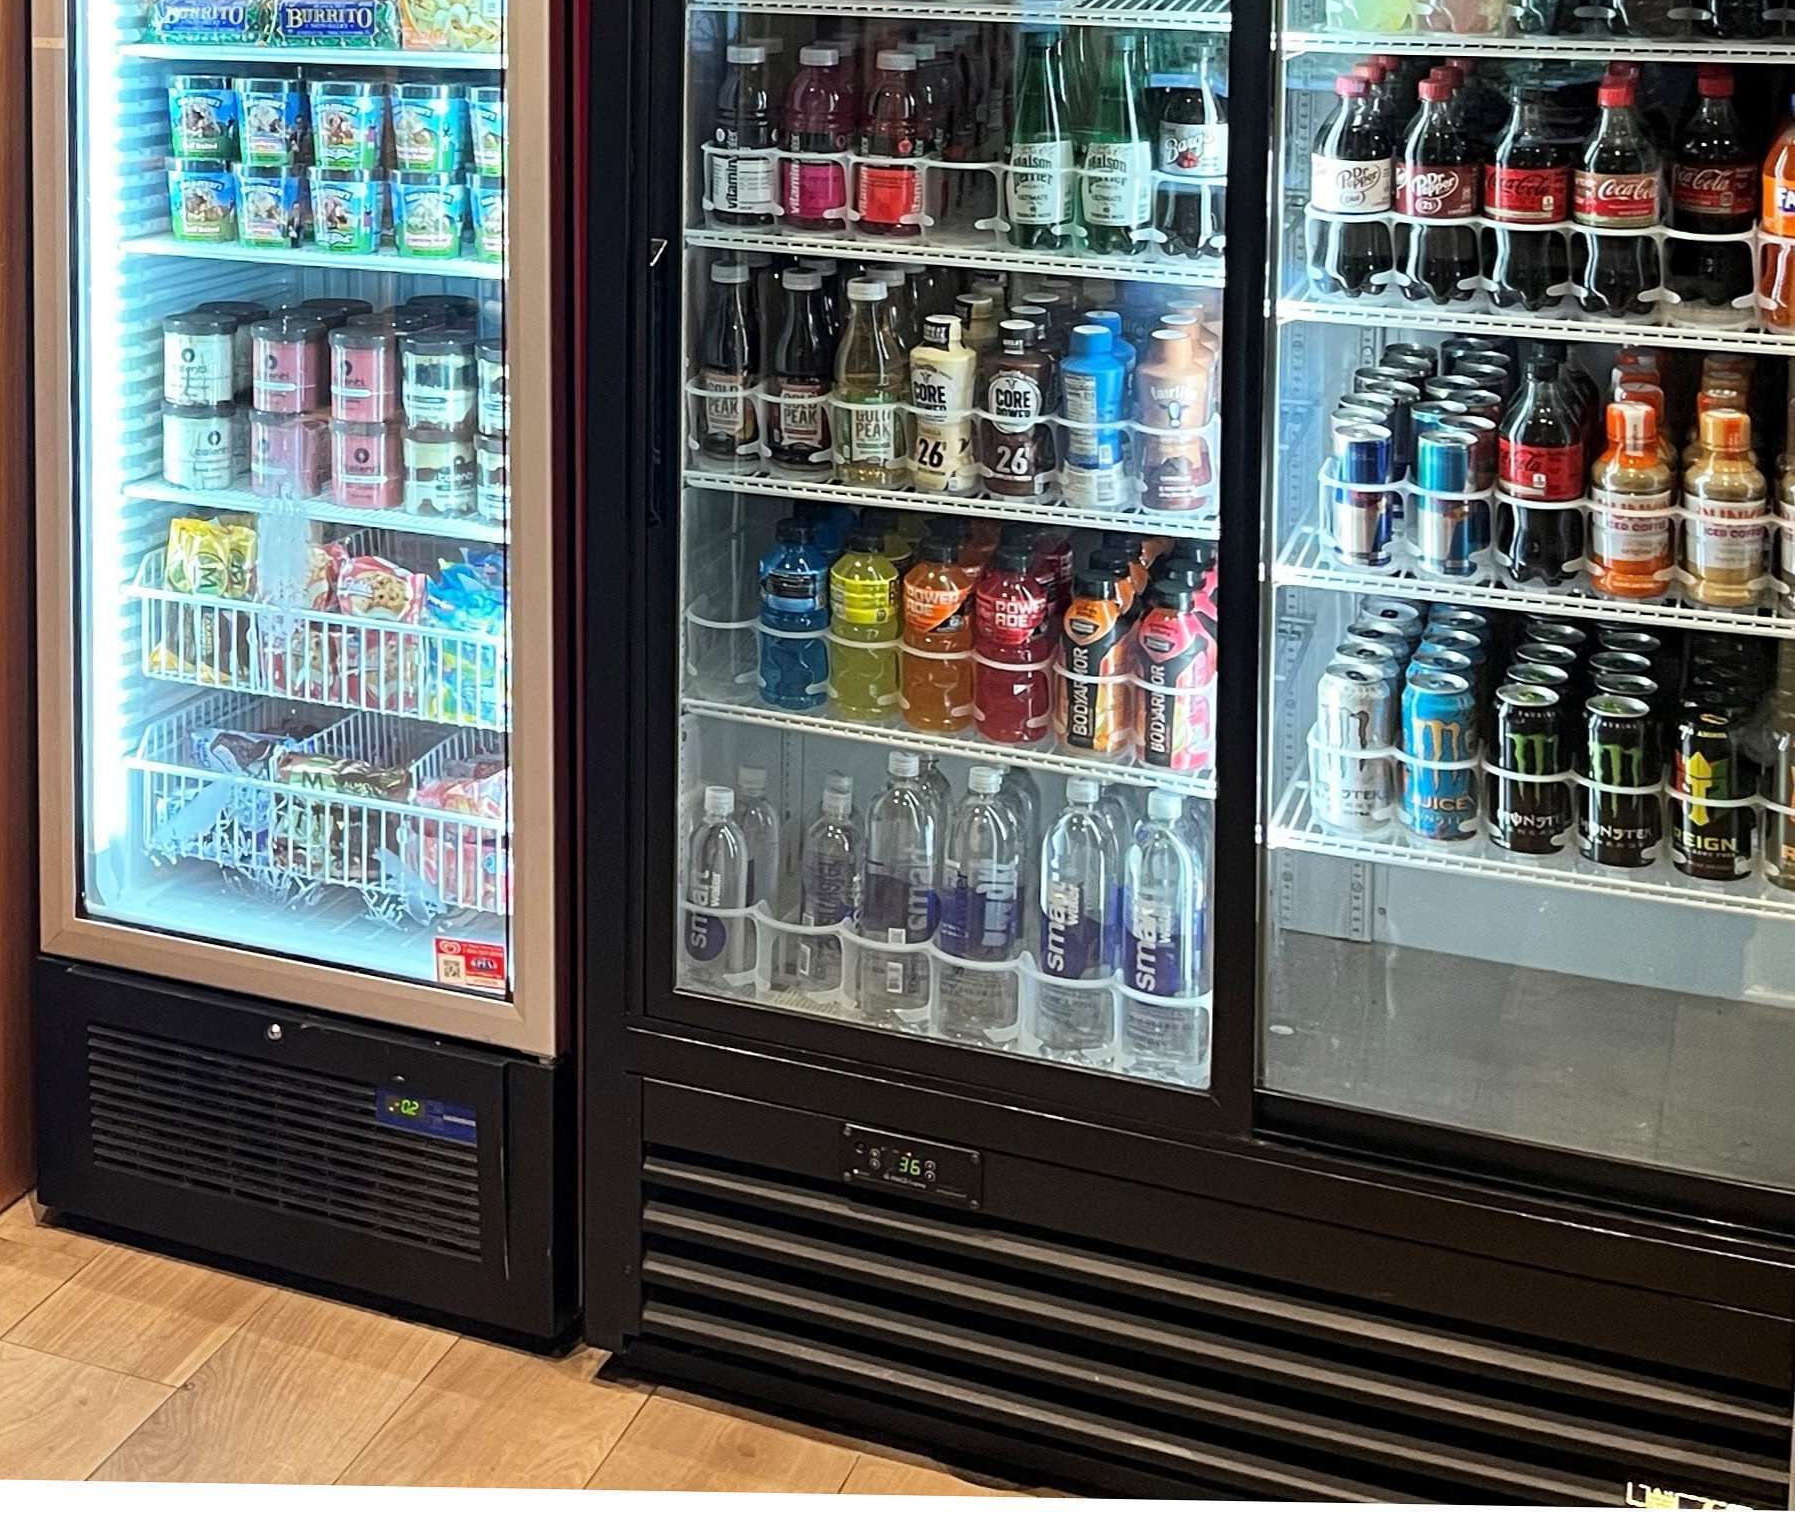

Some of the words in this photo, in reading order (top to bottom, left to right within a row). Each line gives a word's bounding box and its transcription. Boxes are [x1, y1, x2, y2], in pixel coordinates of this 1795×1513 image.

[285, 6, 373, 29] BURRITO
[1337, 170, 1378, 191] Pepper
[1352, 165, 1369, 178] Dr
[1428, 173, 1445, 185] Dr
[1412, 175, 1455, 198] Pepper
[913, 382, 946, 403] CORE
[995, 388, 1031, 408] CORE
[708, 396, 739, 415] PEAK
[784, 408, 818, 425] PEAK
[856, 422, 891, 438] PEAK
[906, 587, 959, 604] POWER
[906, 599, 934, 616] ADE
[995, 598, 1047, 615] POWER
[995, 612, 1029, 628] ADE
[1150, 664, 1166, 753] BODYAROR
[1674, 827, 1737, 852] REIGN
[898, 1156, 921, 1176] 36
